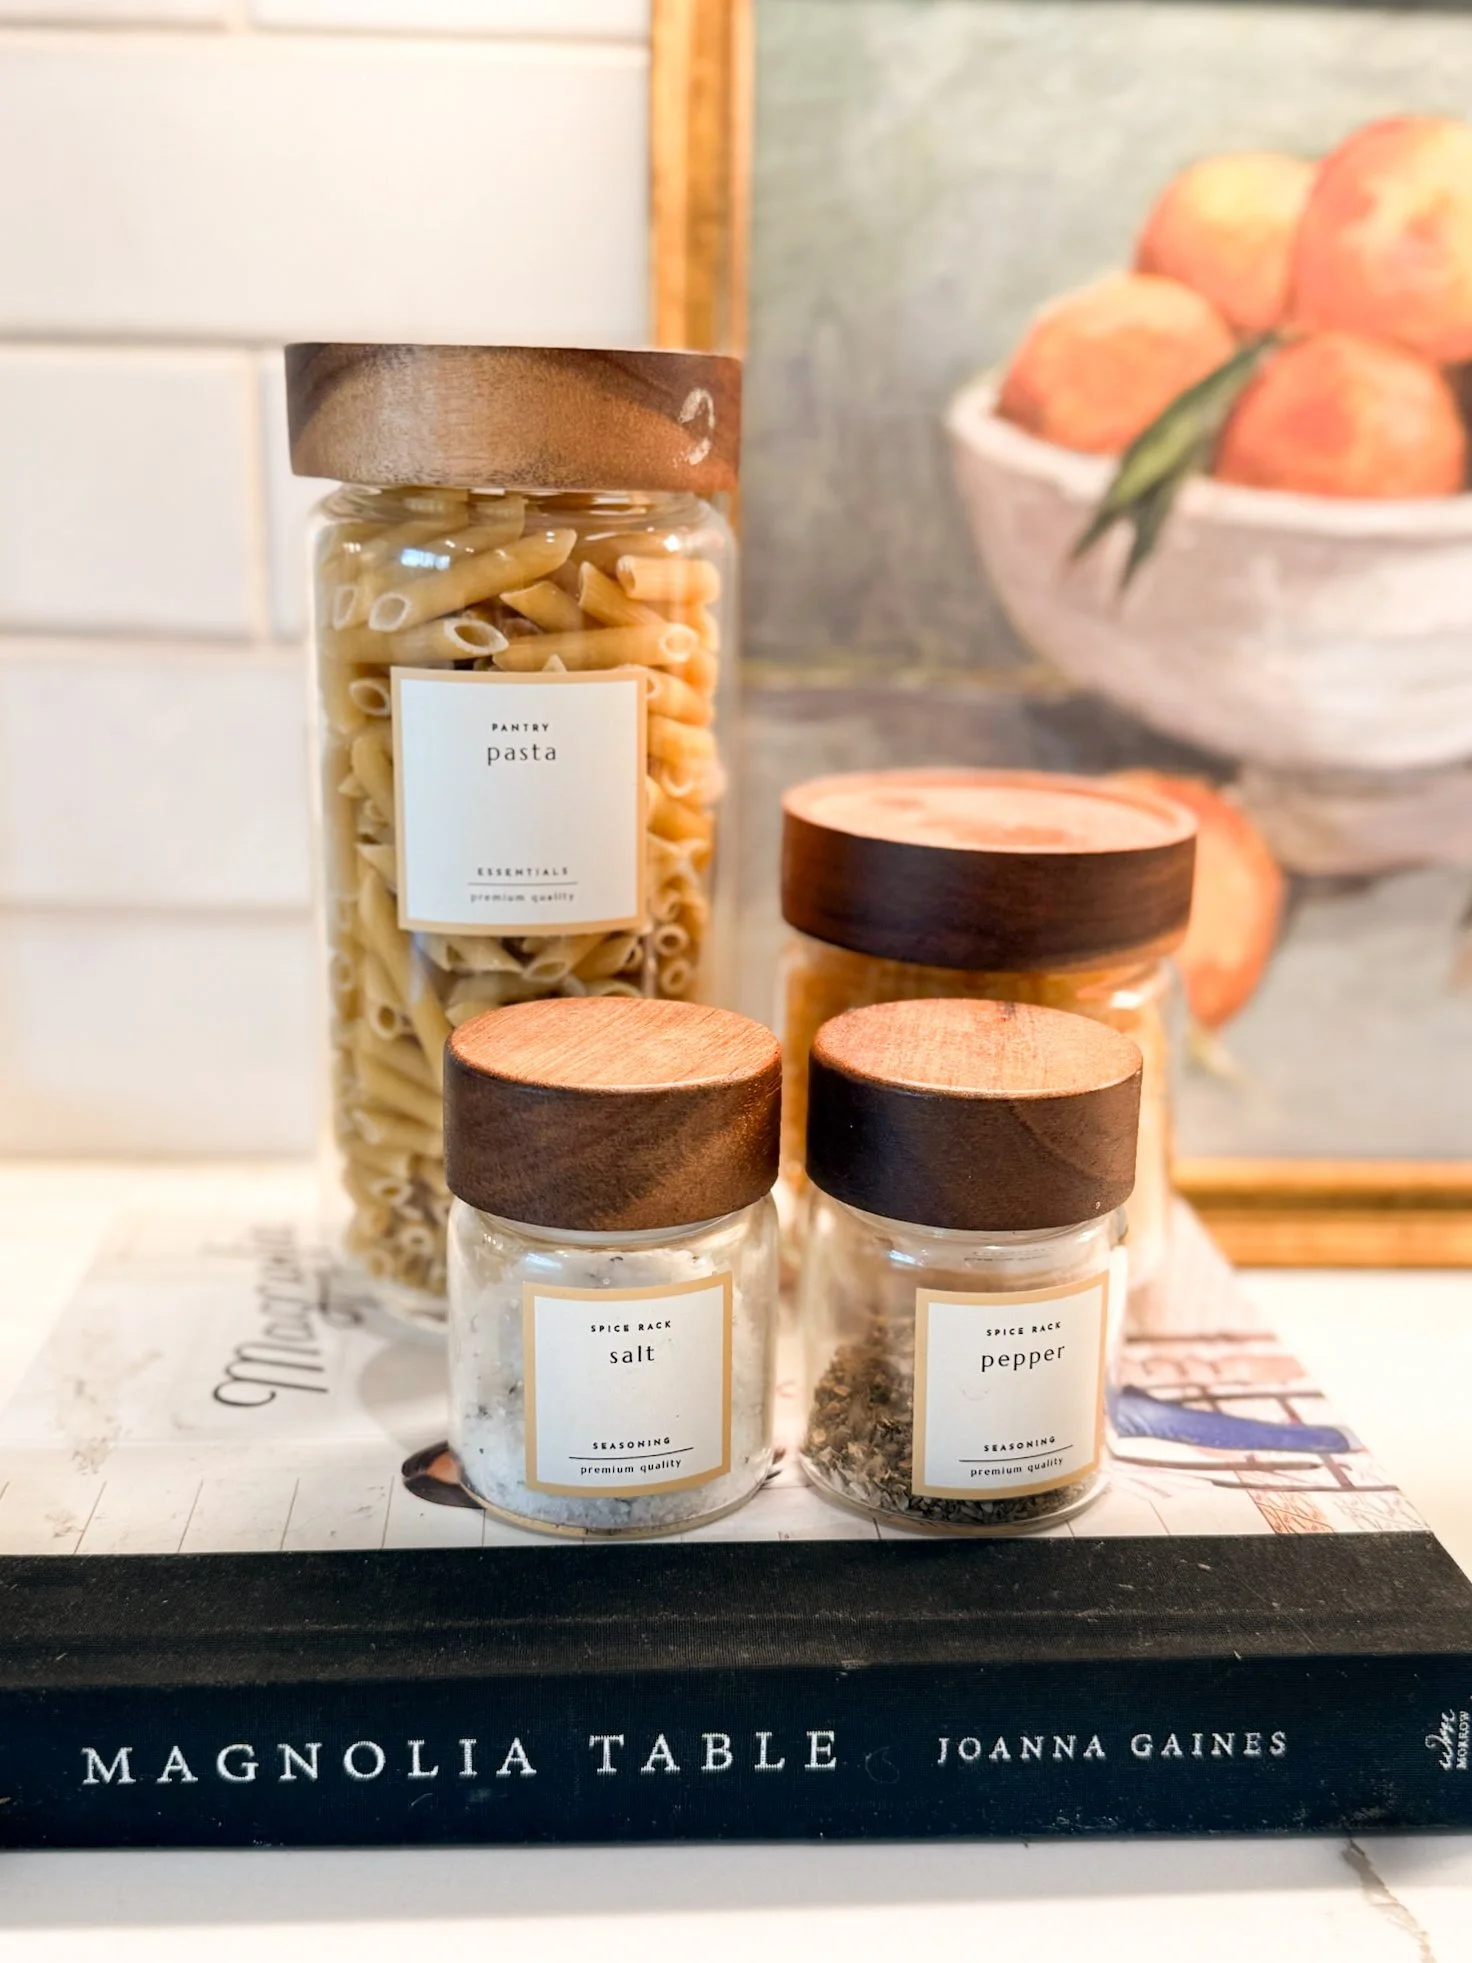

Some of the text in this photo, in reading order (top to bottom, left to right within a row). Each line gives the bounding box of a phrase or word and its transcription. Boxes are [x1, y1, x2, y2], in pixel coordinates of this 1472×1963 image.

[491, 723, 549, 732] PANTRY
[487, 743, 557, 766] pasta
[477, 867, 568, 876] ESSENTIALS
[470, 893, 525, 903] premium
[590, 1320, 672, 1333] SPICE RACK
[986, 1321, 1062, 1336] SPICE RACK
[609, 1345, 655, 1364] salt
[981, 1345, 1066, 1373] pepper
[592, 1437, 671, 1450] SEASONING
[984, 1436, 1056, 1452] SEASONING
[580, 1459, 682, 1475] premium quality
[970, 1457, 1064, 1478] premium quality
[937, 1731, 1287, 1764] JOANNA GAINES
[1456, 1710, 1471, 1770] MORROW
[81, 1731, 837, 1785] MAGNOLIA TABLE
